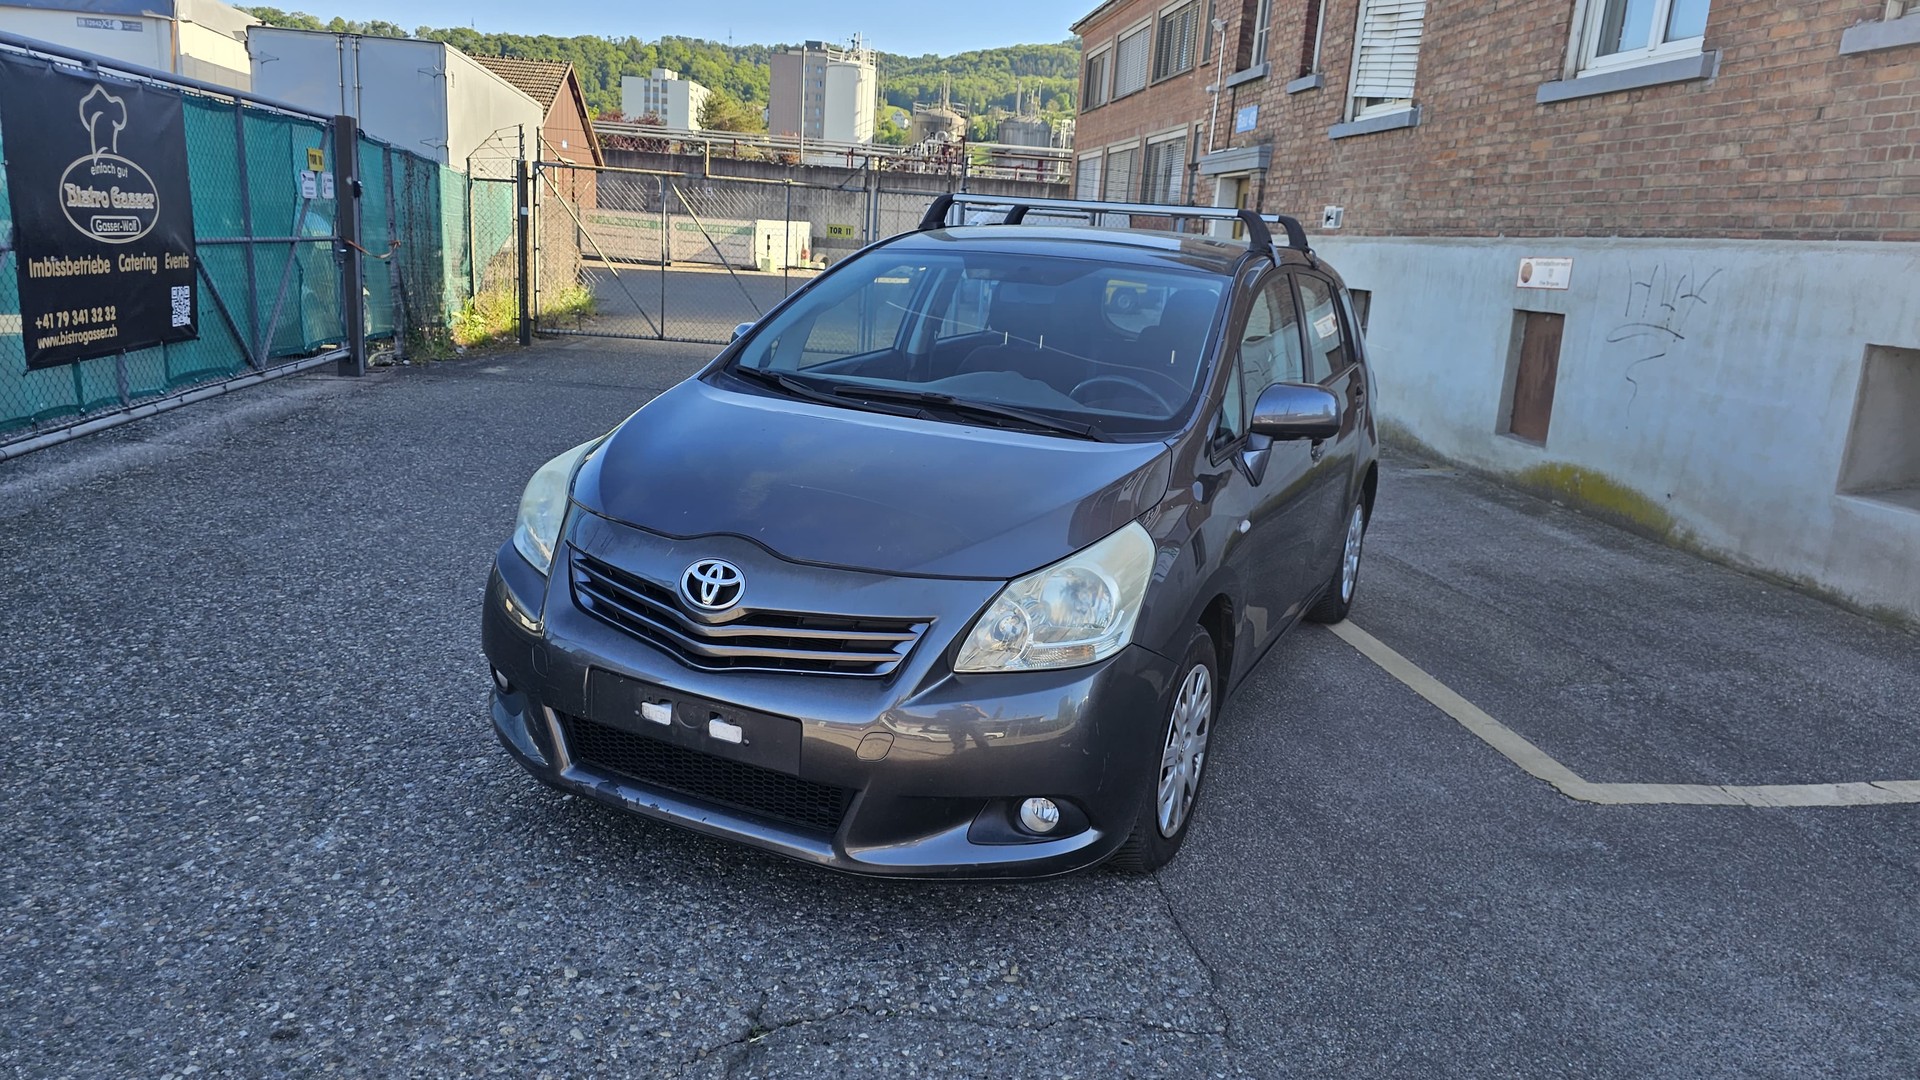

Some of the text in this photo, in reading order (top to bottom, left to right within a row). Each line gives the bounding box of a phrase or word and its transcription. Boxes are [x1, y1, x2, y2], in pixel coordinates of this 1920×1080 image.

[117, 165, 128, 179] gut
[64, 183, 155, 209] Bistro Gasser
[829, 226, 843, 235] TOR
[29, 252, 189, 278] Imbissbetriebe Catering Events
[35, 306, 116, 329] +41 79 341 32 32
[37, 324, 118, 349] www.bistrogasser.ch
